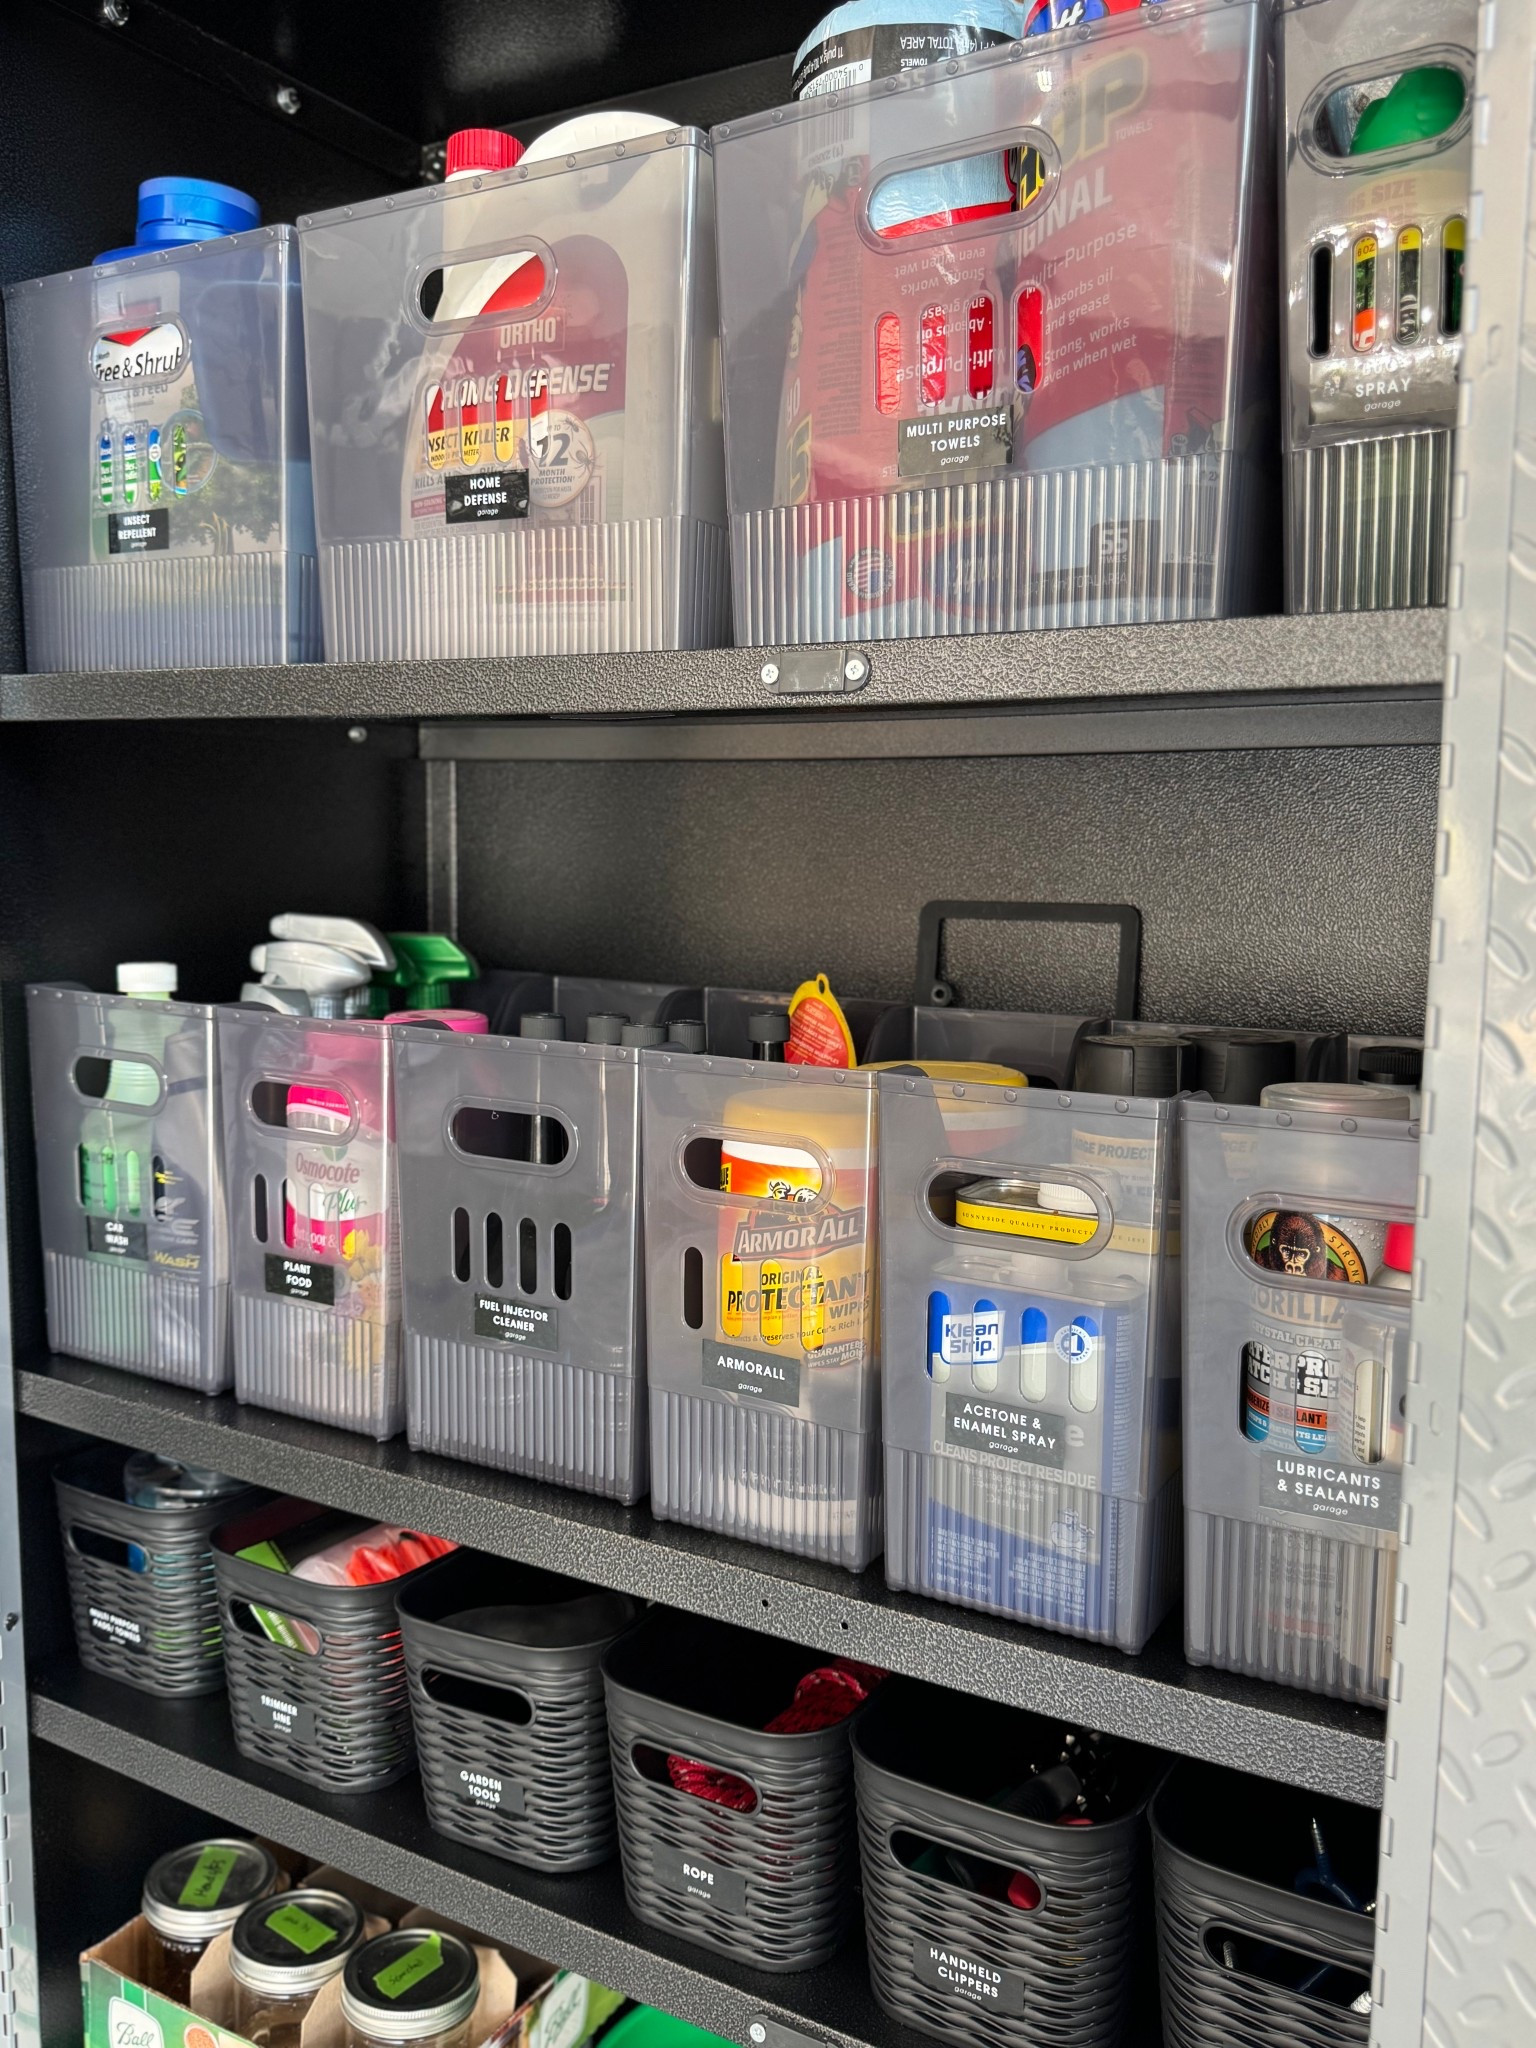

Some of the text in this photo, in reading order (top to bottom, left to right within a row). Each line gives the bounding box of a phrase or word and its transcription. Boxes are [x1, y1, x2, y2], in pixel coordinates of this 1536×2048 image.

[900, 36, 926, 49] AREA
[1046, 266, 1114, 315] Absorbs oil
[1045, 292, 1111, 336] and grease
[500, 318, 558, 349] ORTHO
[1089, 315, 1131, 341] works
[122, 357, 133, 378] &
[1043, 333, 1138, 388] even when wet
[504, 363, 610, 402] DEFENSE
[1355, 377, 1412, 398] SPRAY
[1364, 399, 1401, 412] garage
[906, 413, 1008, 438] MULTI PURPOSE
[536, 432, 571, 469] 12
[930, 435, 981, 454] TOWELS
[940, 452, 970, 466] garage
[538, 468, 566, 477] MONTH
[469, 476, 501, 490] HOME
[463, 492, 508, 507] DEFENSE
[123, 513, 150, 526] INSECT
[477, 508, 499, 517] garage
[118, 527, 157, 540] REPELLENT
[295, 1152, 361, 1184] Osmocote
[104, 1222, 124, 1233] CAR
[961, 1212, 1094, 1237] SUNNYSIDE QUALITY PRODUCTS
[104, 1233, 129, 1246] WASH
[283, 1260, 312, 1275] PLANT
[286, 1274, 313, 1289] FOOD
[479, 1299, 549, 1322] FUEL INJECTOR
[492, 1315, 535, 1332] CLEANER
[945, 1322, 999, 1338] Klean
[504, 1331, 527, 1341] garage
[950, 1338, 993, 1356] Strip
[717, 1355, 786, 1381] ARMORALL
[738, 1382, 763, 1393] garage
[963, 1402, 1042, 1430] ACETONE &
[953, 1417, 1057, 1450] ENAMEL SPRAY
[988, 1440, 1019, 1454] garage
[933, 1439, 978, 1464] CLEANS
[979, 1451, 1034, 1476] PROJECT
[1036, 1464, 1098, 1490] RESIDUE
[1276, 1459, 1381, 1490] LUBRICANTS
[1277, 1478, 1380, 1509] & SEALANTS
[1312, 1502, 1349, 1516] garage
[261, 1694, 298, 1716] TRIMMER
[272, 1710, 292, 1726] LINE
[460, 1770, 502, 1791] GARDEN
[468, 1784, 501, 1803] TOOLS
[682, 1863, 715, 1885] ROPE
[687, 1884, 711, 1899] garage
[930, 1947, 1001, 1983] HANDHELD
[937, 1966, 999, 1998] CLIPPERS
[954, 1986, 982, 2001] garage
[116, 2021, 155, 2048] Ball
